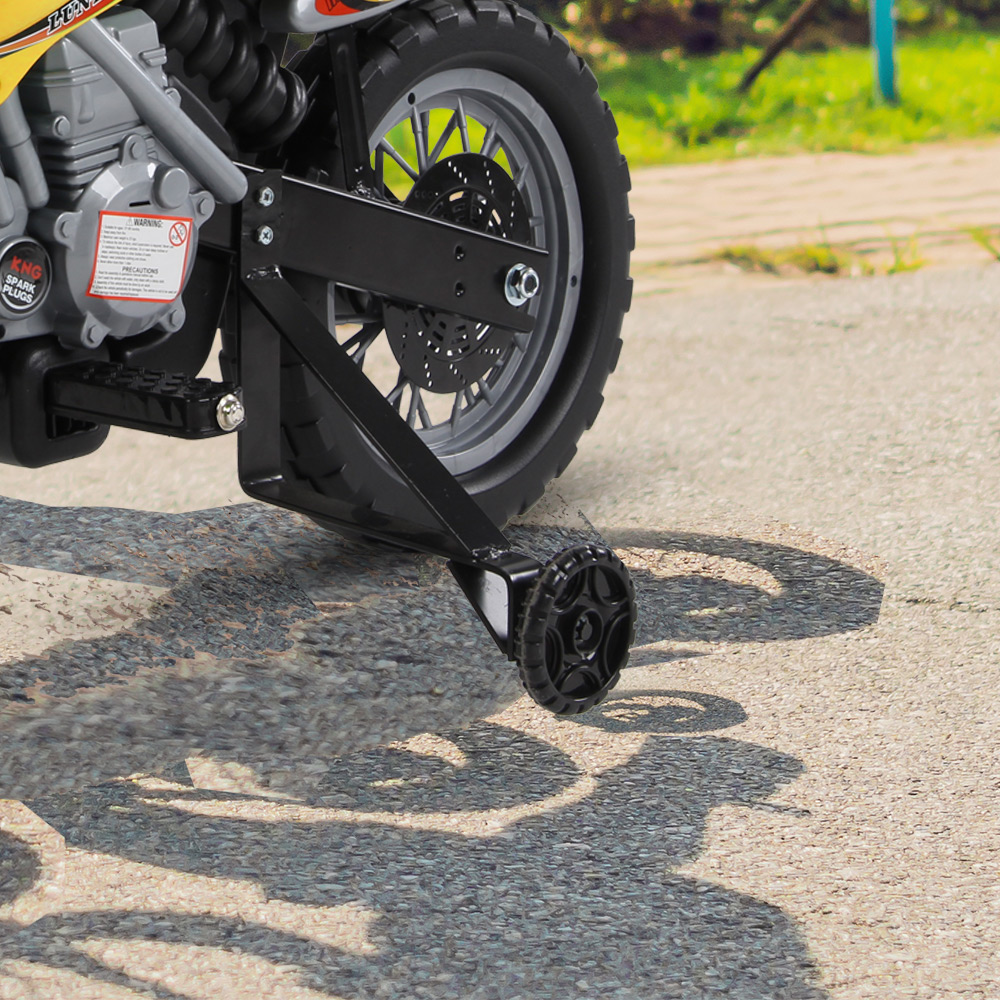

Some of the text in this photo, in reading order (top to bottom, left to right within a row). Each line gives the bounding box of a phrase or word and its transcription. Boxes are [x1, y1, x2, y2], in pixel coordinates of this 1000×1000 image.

[10, 255, 43, 280] KNG
[121, 265, 159, 275] PRECAUTIONS
[2, 283, 33, 304] PLUGS
[5, 274, 36, 294] SPARK
